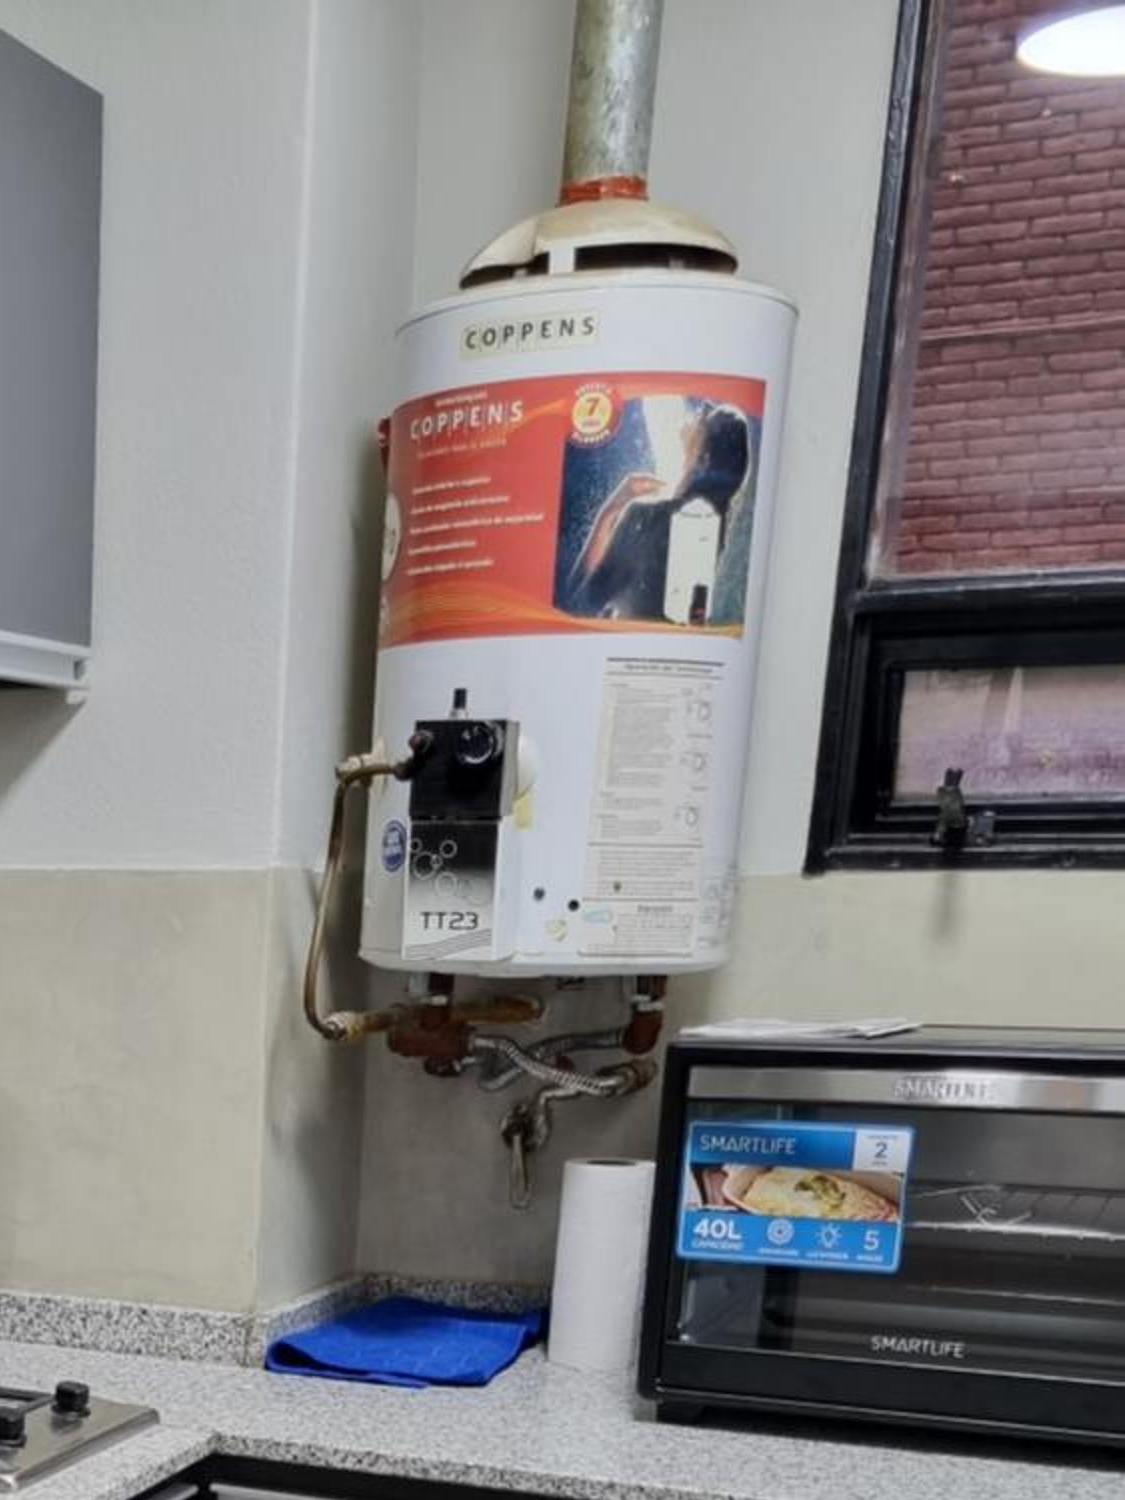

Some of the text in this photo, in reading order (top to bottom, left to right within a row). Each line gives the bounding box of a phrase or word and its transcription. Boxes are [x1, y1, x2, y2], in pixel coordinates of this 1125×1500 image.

[465, 316, 594, 350] COPPENS
[585, 397, 600, 416] 7
[411, 400, 524, 440] COPPENS
[420, 911, 478, 931] TT23
[699, 1135, 796, 1154] SMARTLIFE
[874, 1142, 888, 1159] 2
[693, 1218, 743, 1240] 40L
[864, 1230, 880, 1251] 5
[871, 1334, 965, 1359] SMARTLIFE
